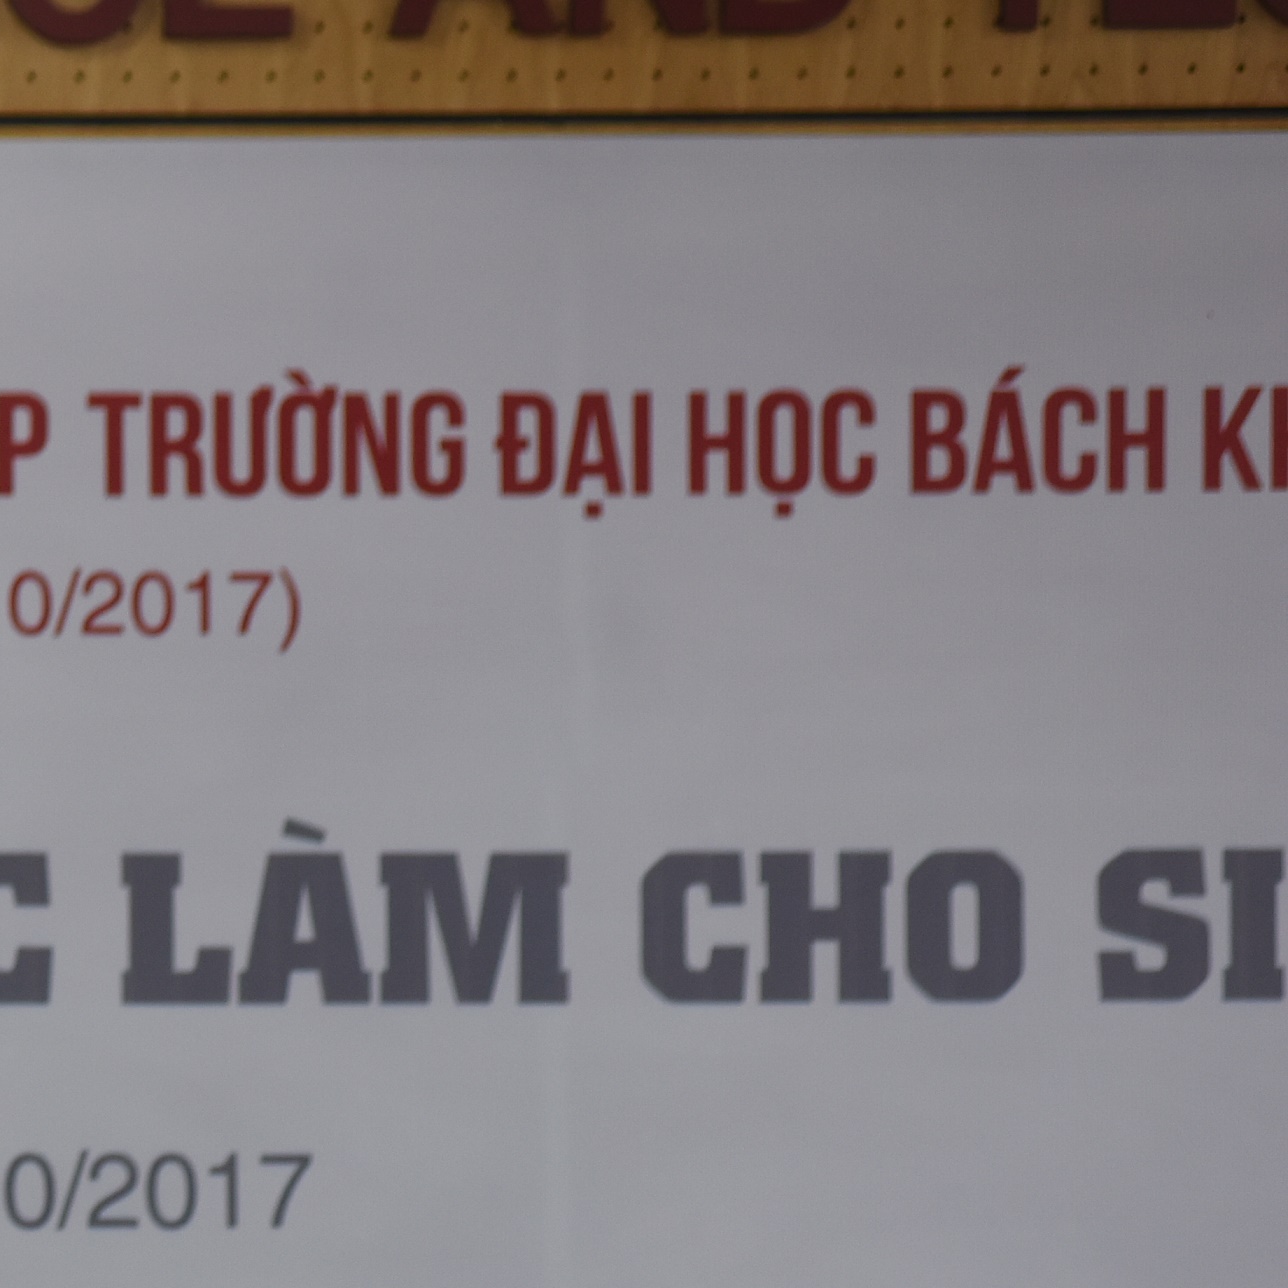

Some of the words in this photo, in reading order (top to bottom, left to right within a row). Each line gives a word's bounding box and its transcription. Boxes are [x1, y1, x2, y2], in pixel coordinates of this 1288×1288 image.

[87, 369, 466, 498] TRƯỜNG
[494, 391, 652, 519] ĐẠI
[688, 388, 876, 518] HỌC
[910, 366, 1166, 494] BÁCH
[120, 817, 570, 1007] LÀM
[640, 848, 1026, 1005] CHO
[1096, 847, 1286, 1003] SI
